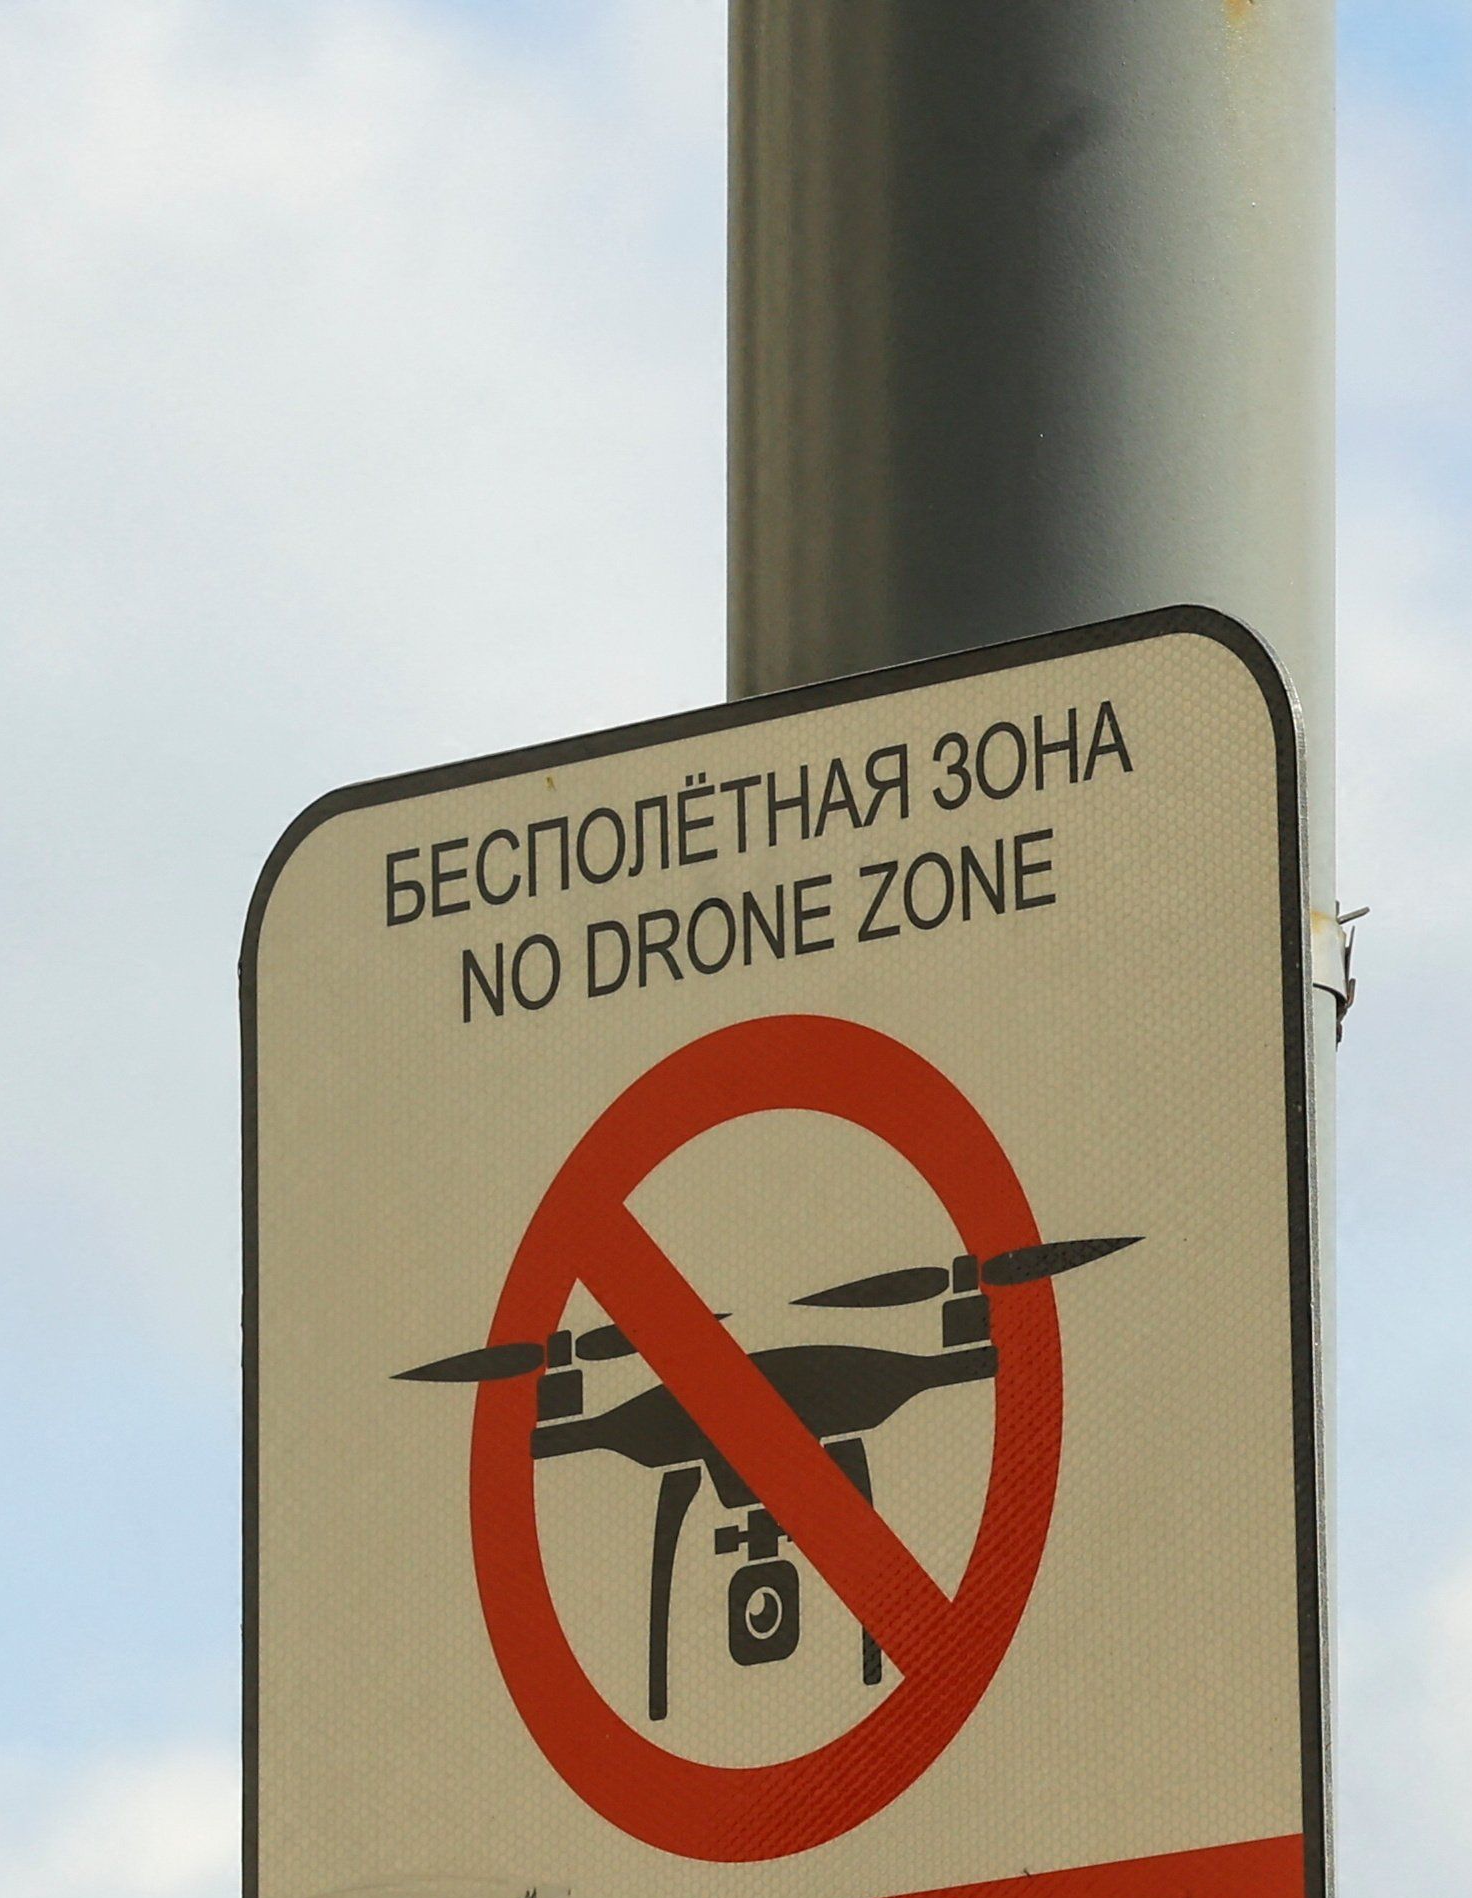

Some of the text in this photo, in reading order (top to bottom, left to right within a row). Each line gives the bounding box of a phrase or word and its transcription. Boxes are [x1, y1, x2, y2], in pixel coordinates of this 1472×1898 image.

[385, 699, 1134, 927] БЕСПОЛЁТНАЯ ЗОНА
[461, 828, 1057, 1024] NO DRONE ZONE
